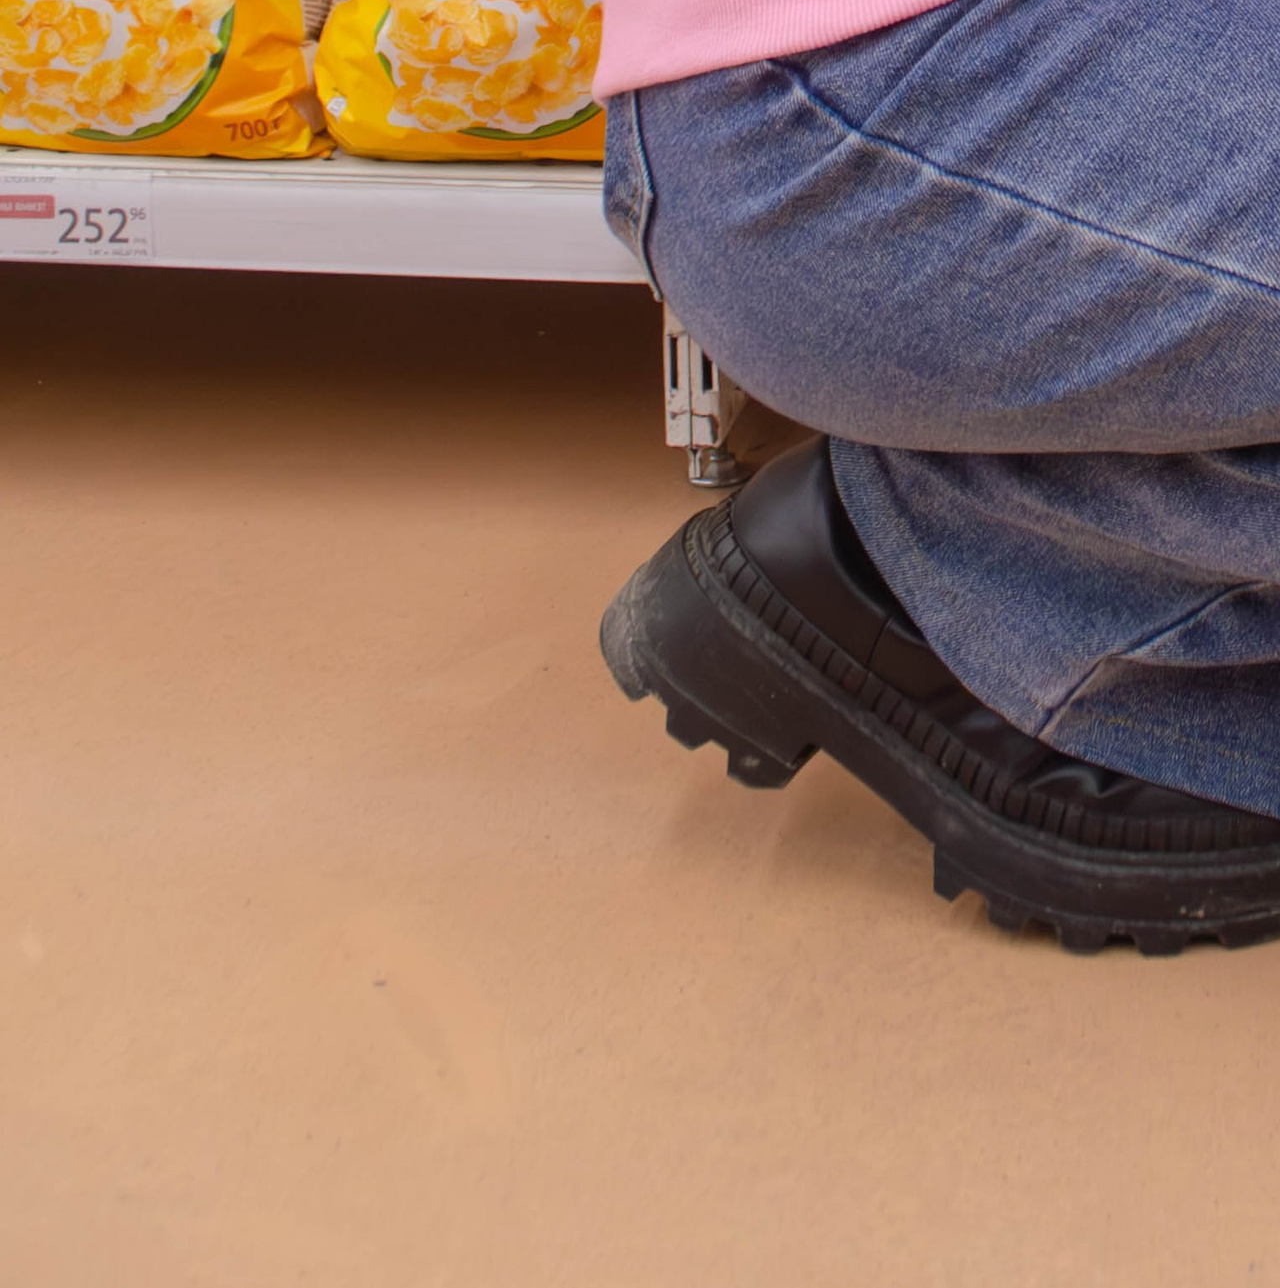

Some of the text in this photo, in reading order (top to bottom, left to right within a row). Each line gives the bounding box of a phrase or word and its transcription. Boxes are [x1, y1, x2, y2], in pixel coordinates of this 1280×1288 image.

[225, 118, 268, 141] 700
[58, 207, 147, 243] 252 96
